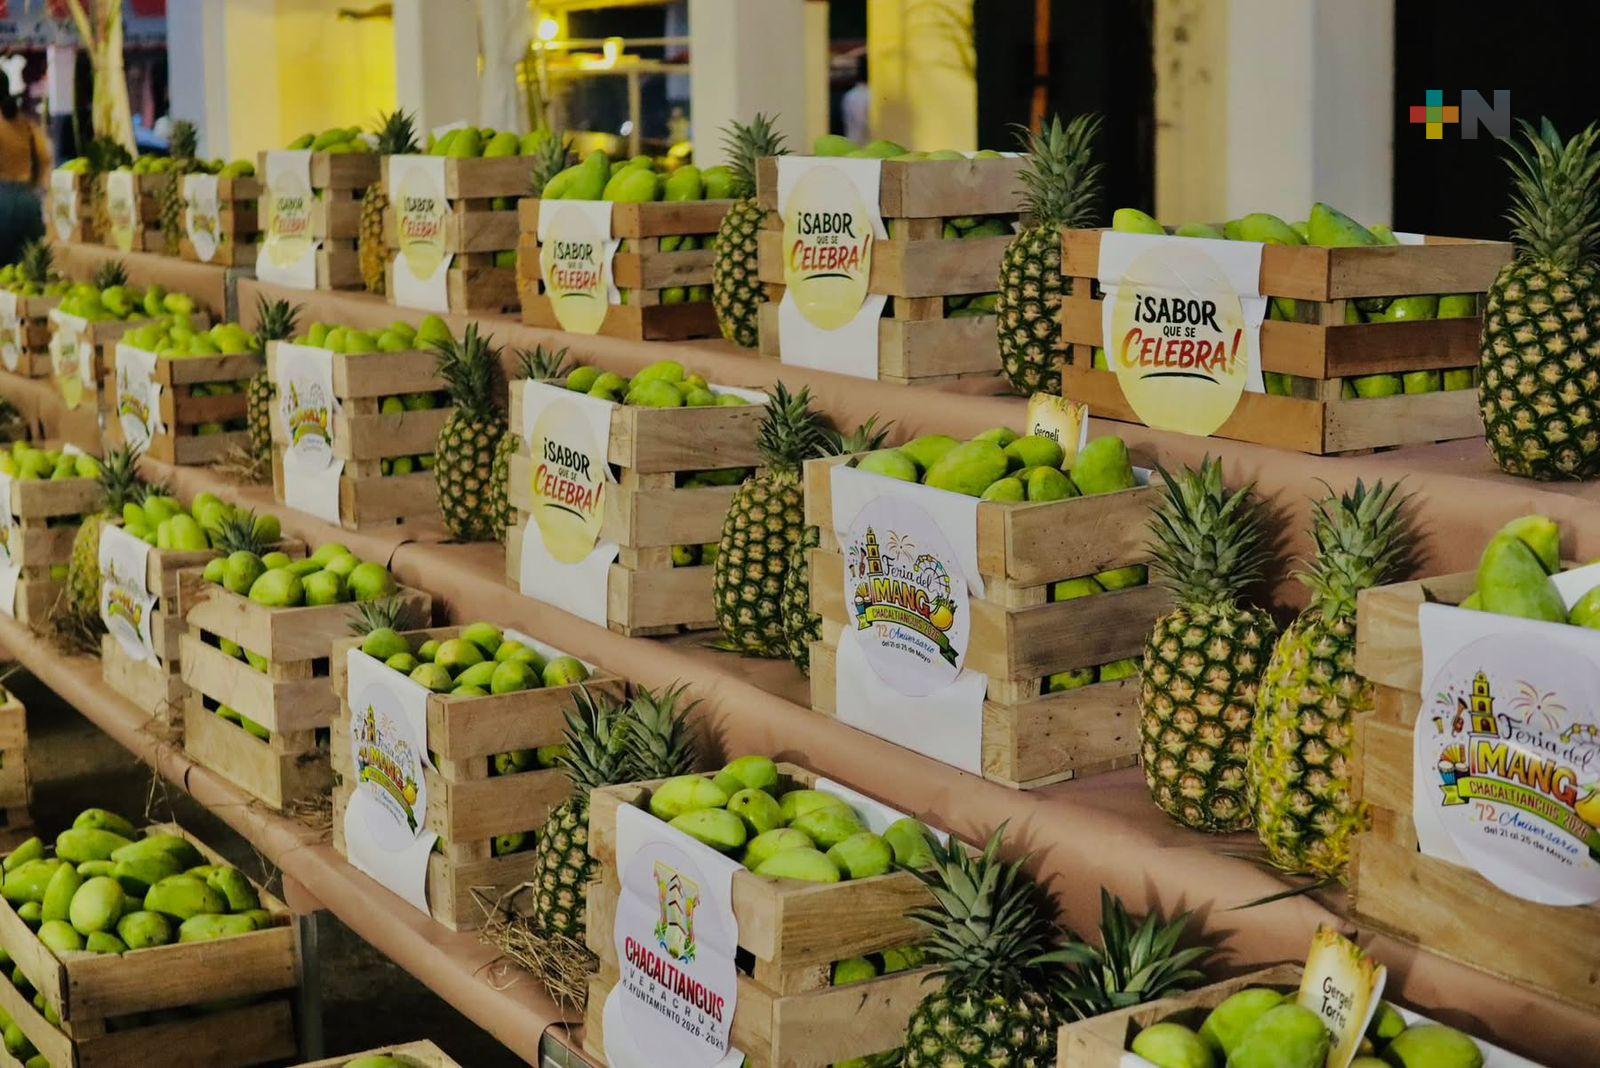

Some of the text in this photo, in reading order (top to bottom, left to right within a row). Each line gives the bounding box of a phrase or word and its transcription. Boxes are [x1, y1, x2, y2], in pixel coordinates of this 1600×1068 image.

[797, 211, 856, 239] ¡SABOR
[553, 240, 596, 266] ¡SABOR
[790, 233, 871, 273] CELEBRA!
[549, 261, 604, 292] CELEBRA!
[1134, 293, 1224, 333] ¡SABOR
[1163, 325, 1196, 338] QUE SE
[1120, 327, 1243, 376] CELEBRA!
[543, 436, 592, 482] ¡SABOR
[533, 463, 604, 518] CELEBRA!
[881, 554, 935, 592] Feria del
[875, 623, 935, 654] 72 Aniversario
[915, 650, 931, 664] Mayo
[1497, 713, 1595, 772] Feria del
[1476, 802, 1579, 855] 72 Aniversario
[1484, 825, 1498, 835] del
[1546, 846, 1573, 866] Mayo
[625, 936, 724, 1023] CHACALTIANGUIS
[629, 983, 681, 1024] AYUNTAMIENTO
